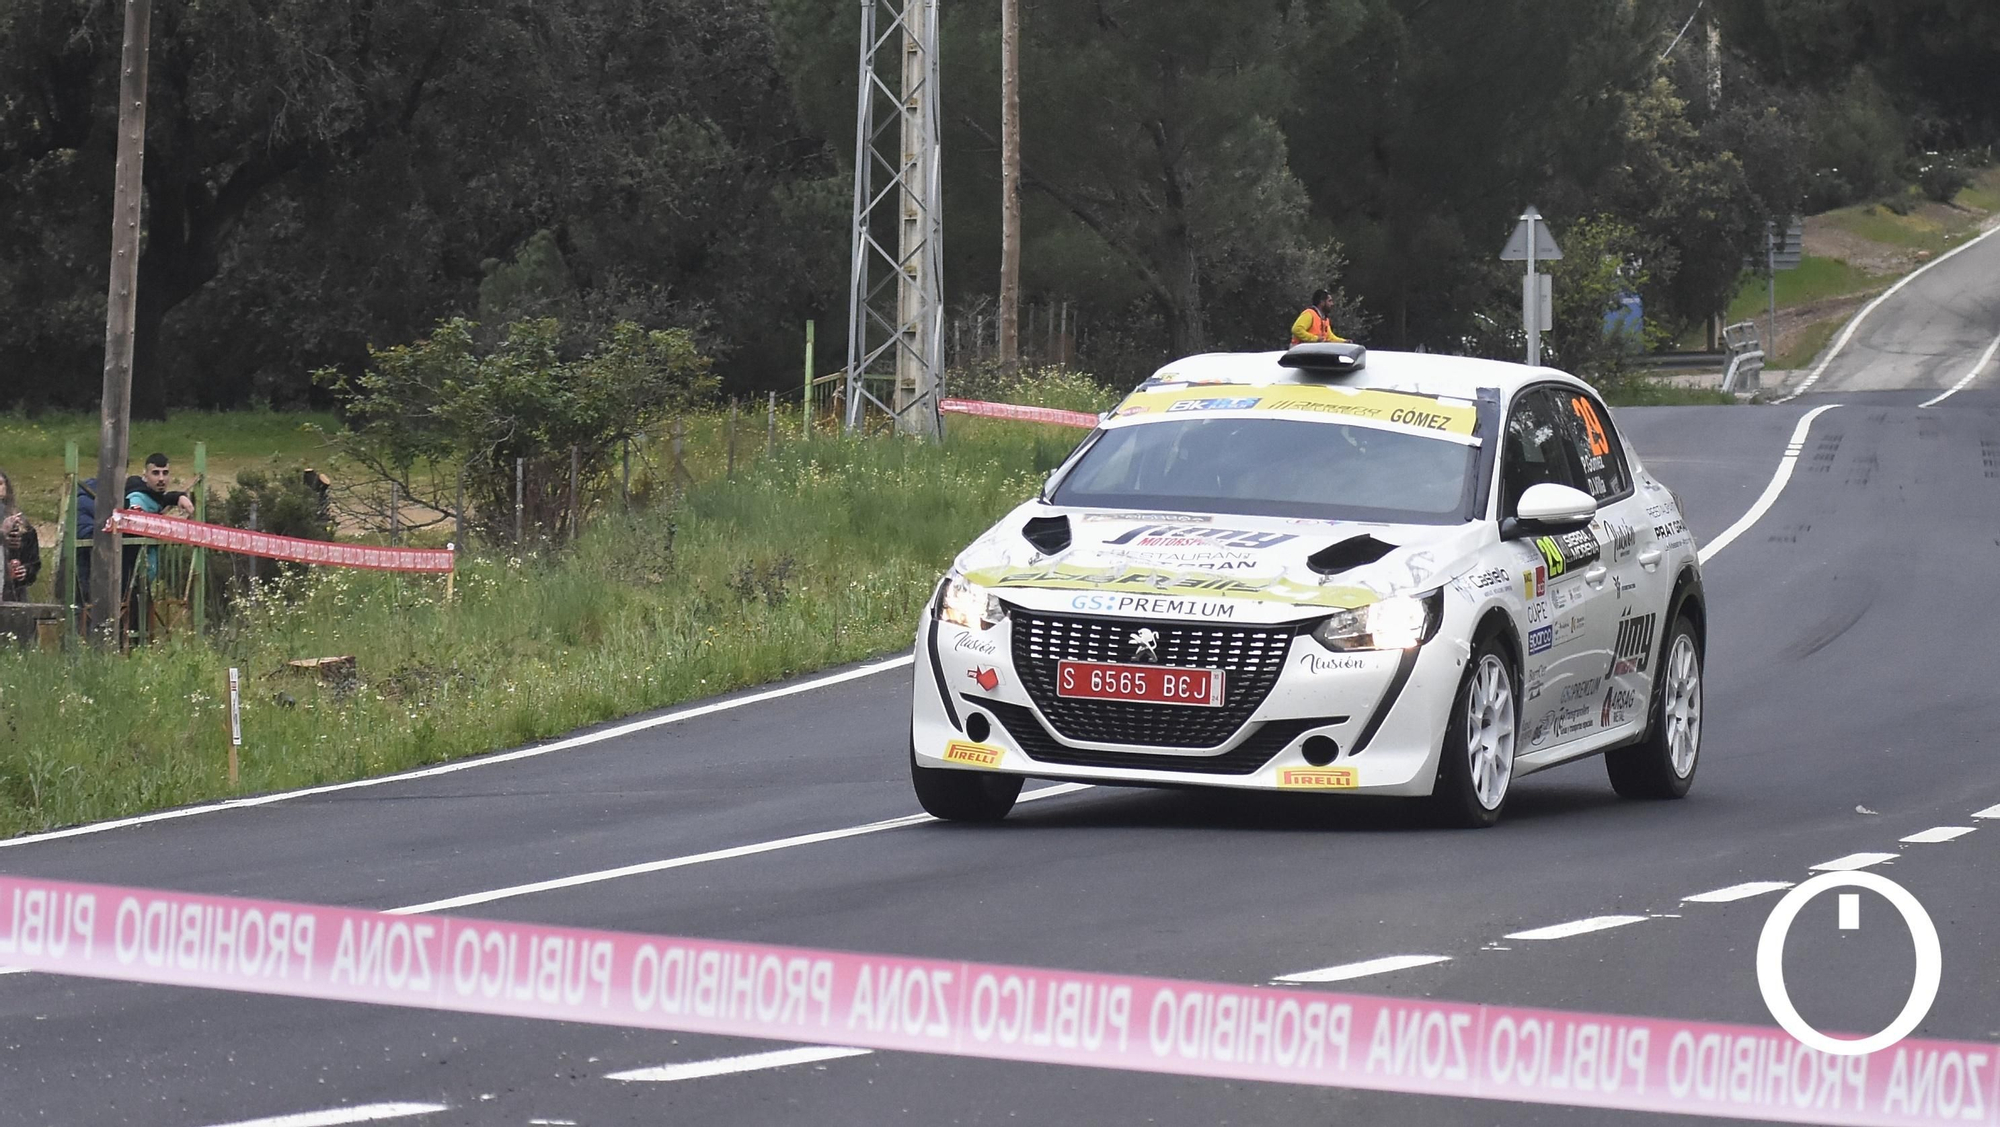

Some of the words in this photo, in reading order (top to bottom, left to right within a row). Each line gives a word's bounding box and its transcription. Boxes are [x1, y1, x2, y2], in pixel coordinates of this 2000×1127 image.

[1391, 407, 1452, 431] GÓMEZ
[1572, 396, 1609, 456] 29
[1536, 536, 1564, 577] 29
[1529, 629, 1552, 651] sparco
[1063, 667, 1075, 690] S
[1091, 670, 1146, 695] 6565
[1163, 674, 1206, 699] BCJ
[948, 744, 998, 764] PIRELLI
[1284, 770, 1351, 786] PIRELLI
